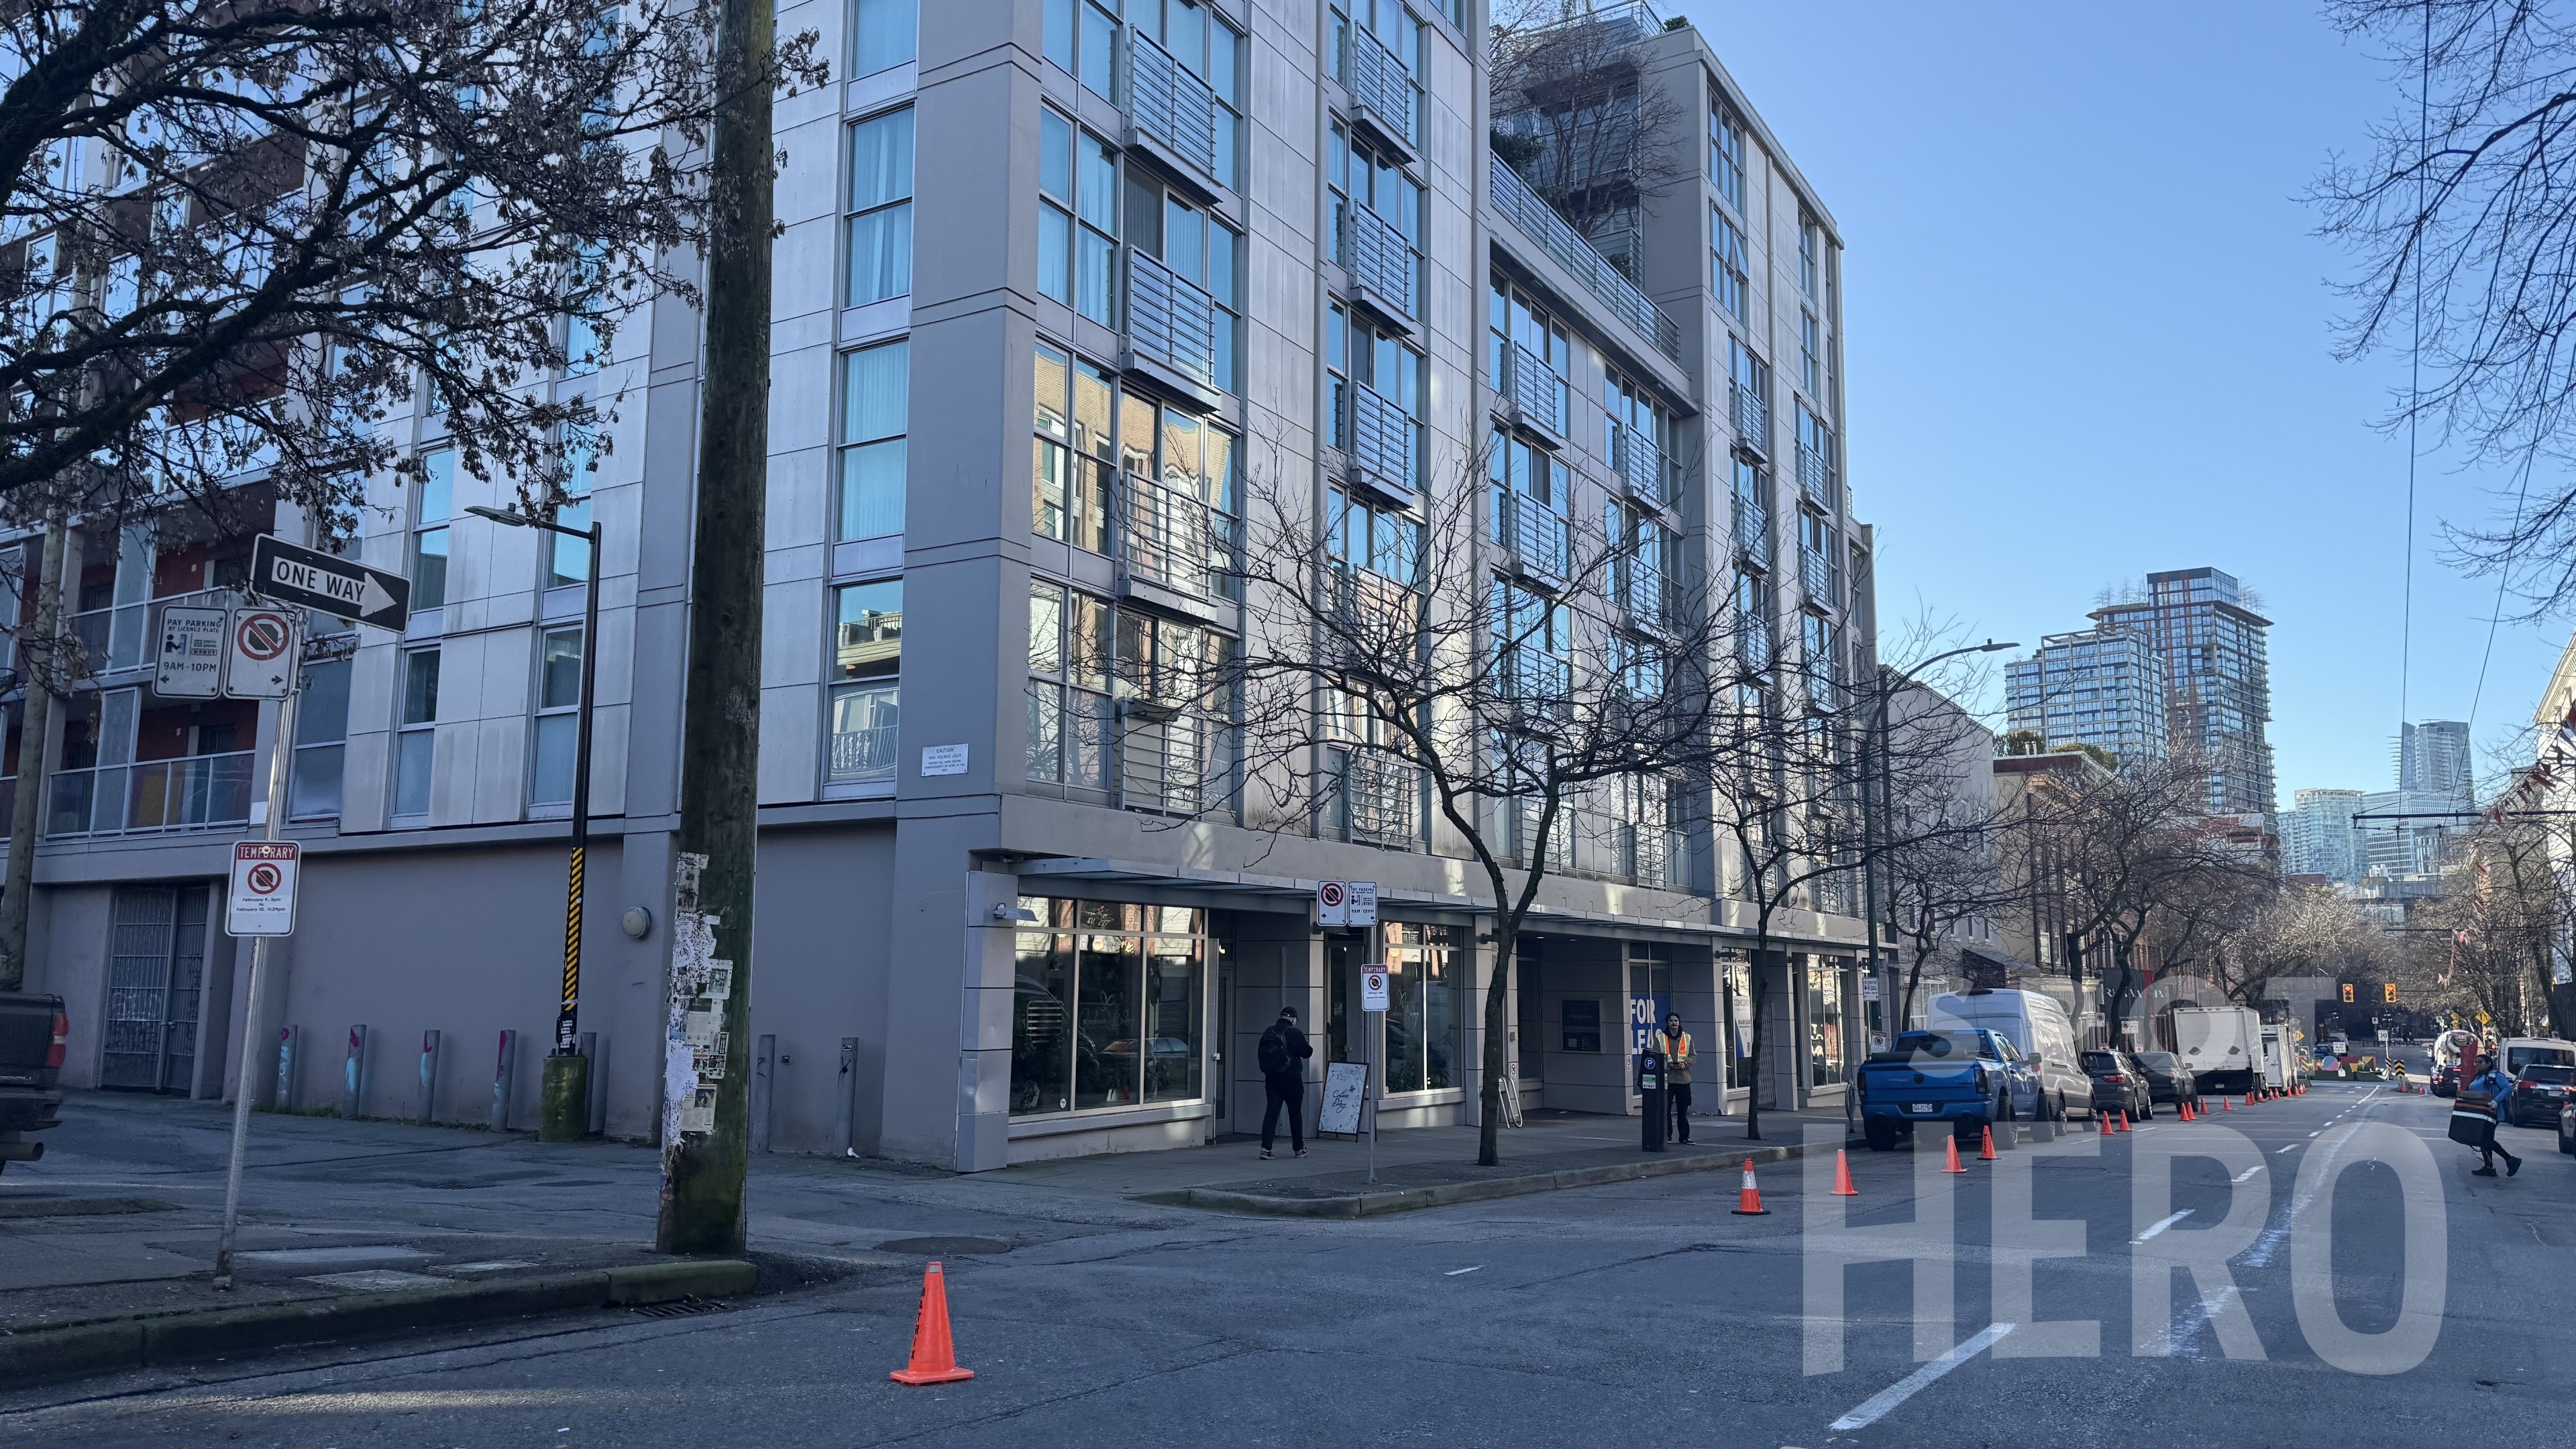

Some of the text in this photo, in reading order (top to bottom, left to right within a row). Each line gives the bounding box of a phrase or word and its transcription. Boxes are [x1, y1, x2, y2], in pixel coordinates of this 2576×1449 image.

[277, 561, 366, 602] ONE WAY
[186, 620, 221, 628] PARKING
[164, 662, 184, 671] 9AM
[192, 663, 217, 672] 10PM
[1630, 999, 1656, 1024] FOR
